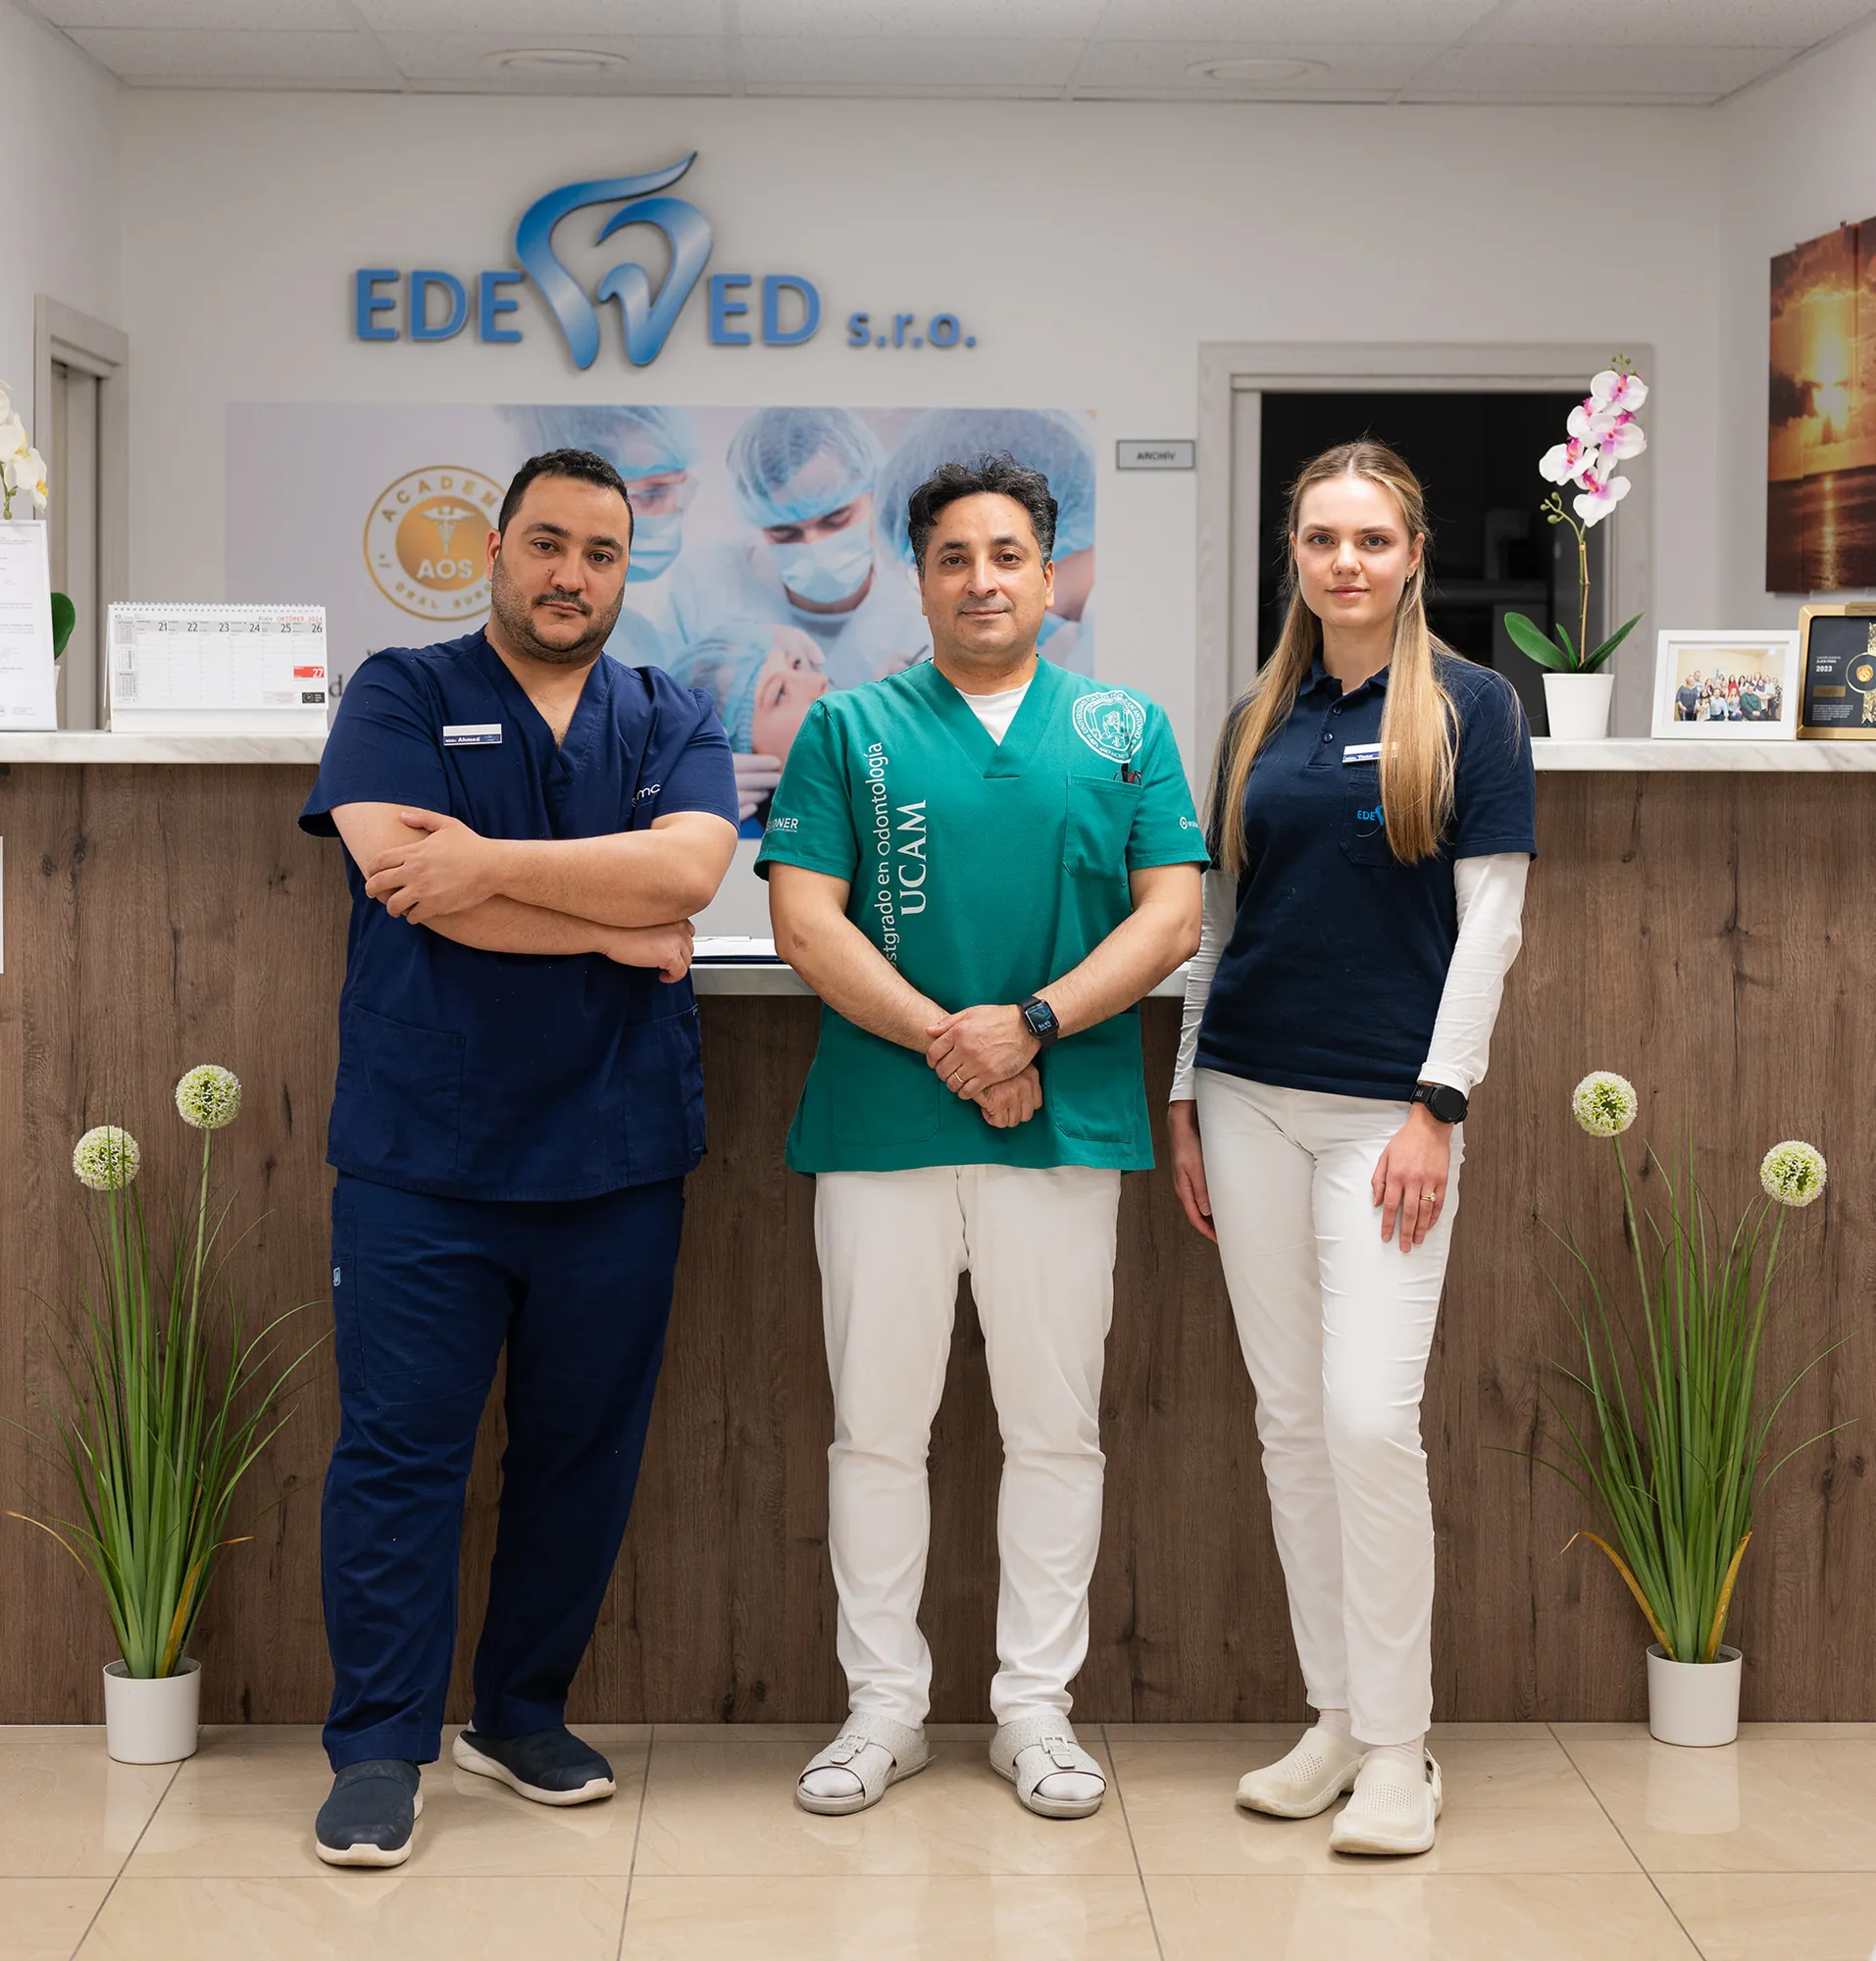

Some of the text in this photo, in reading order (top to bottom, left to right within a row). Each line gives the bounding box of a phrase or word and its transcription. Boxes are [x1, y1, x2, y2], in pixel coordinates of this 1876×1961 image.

[847, 312, 977, 347] s.r.o.
[381, 476, 498, 523] ACADEM
[416, 558, 474, 580] AOS
[158, 621, 168, 631] 21
[187, 622, 198, 632] 22
[219, 623, 229, 632] 23
[249, 623, 260, 633] 24
[280, 624, 291, 633] 25
[311, 624, 323, 633] 26
[312, 668, 324, 679] 27
[863, 742, 900, 968] stgrado en odontología
[896, 800, 927, 916] UCAM
